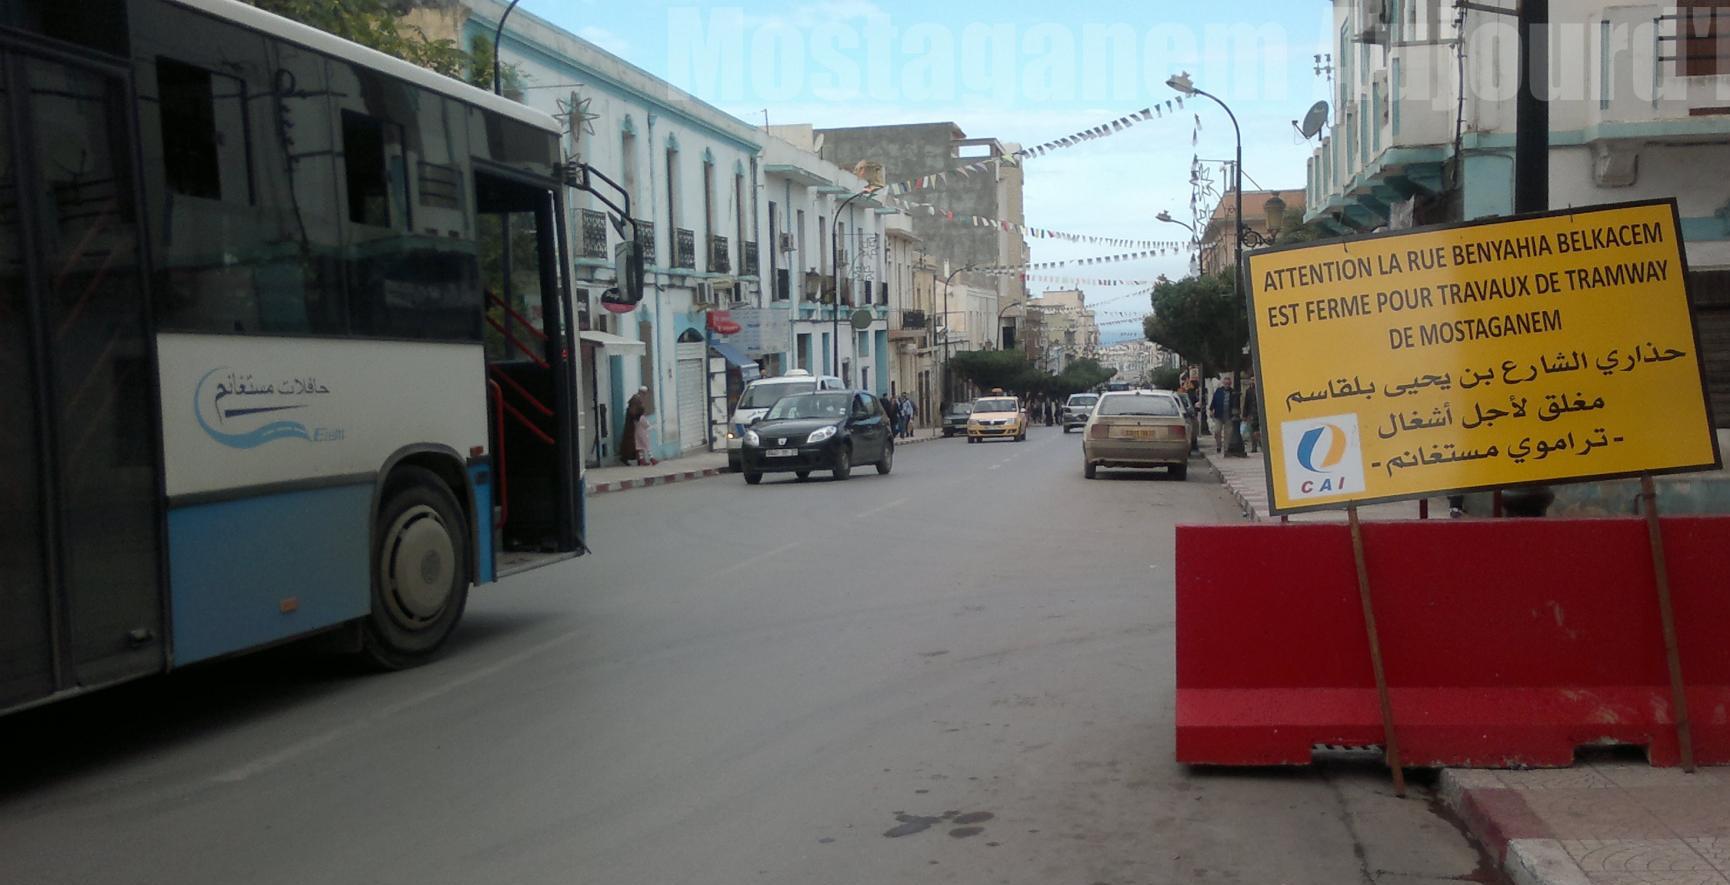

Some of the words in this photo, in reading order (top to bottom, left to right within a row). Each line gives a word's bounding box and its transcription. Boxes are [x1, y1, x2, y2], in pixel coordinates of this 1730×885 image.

[1263, 256, 1373, 293] ATTENTION
[1378, 253, 1403, 276] LA
[1407, 247, 1448, 272] RUE
[1452, 234, 1553, 266] BENYAHIA
[1557, 222, 1664, 254] BELKACEM
[1267, 303, 1300, 328] EST
[1305, 294, 1372, 322] FERME
[1376, 287, 1433, 313] POUR
[1436, 275, 1531, 306] TRAVAUX
[1535, 271, 1561, 295] DE
[1565, 259, 1668, 291] TRAMWAY
[1389, 326, 1416, 350] DE
[1419, 309, 1563, 347] MOSTAGANEM
[1501, 350, 1588, 385] الشارع
[1595, 342, 1687, 376] حذاري
[278, 376, 331, 396] حافلات
[1285, 375, 1376, 413] بلقاسم
[1383, 372, 1452, 398] يحيى
[1459, 367, 1495, 389] بن
[214, 372, 275, 425] مستغانم
[1461, 394, 1528, 429] لأجل
[1537, 391, 1605, 422] مغلق
[1377, 401, 1453, 440] أشغال
[1300, 476, 1346, 494] CAI
